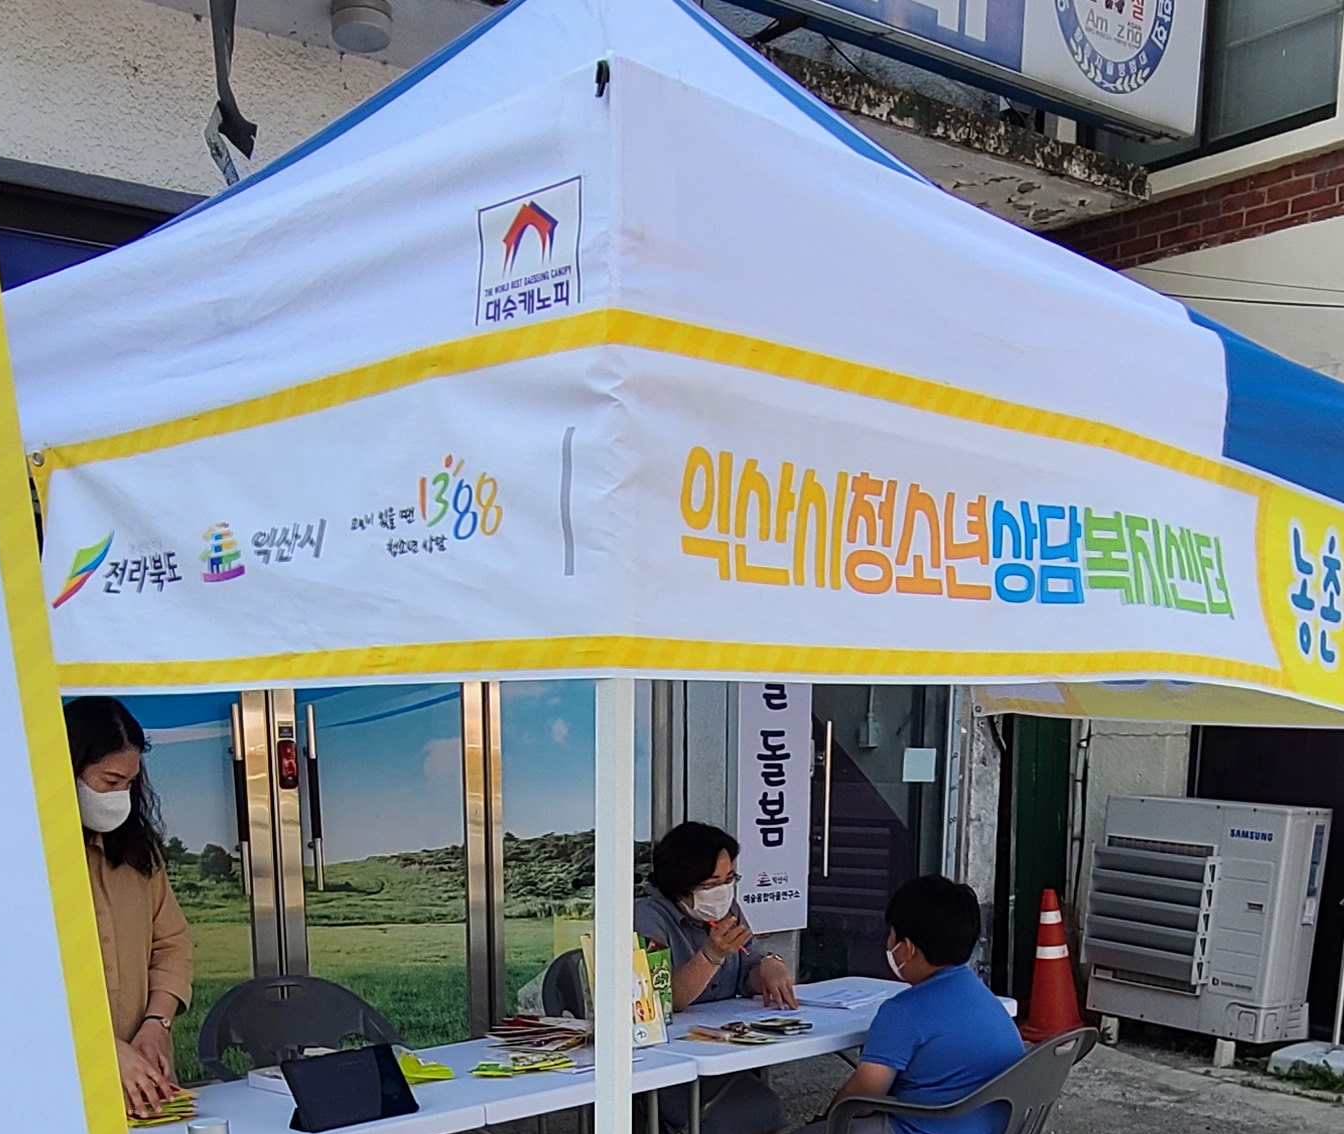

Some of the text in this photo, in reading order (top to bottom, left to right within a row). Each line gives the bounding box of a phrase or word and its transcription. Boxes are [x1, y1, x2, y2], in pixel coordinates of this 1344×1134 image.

[418, 471, 503, 540] 1388
[251, 518, 327, 564] 익산시
[102, 551, 182, 594] 전라북도
[756, 730, 790, 847] 돌봄
[1230, 828, 1274, 842] SAMSUNG
